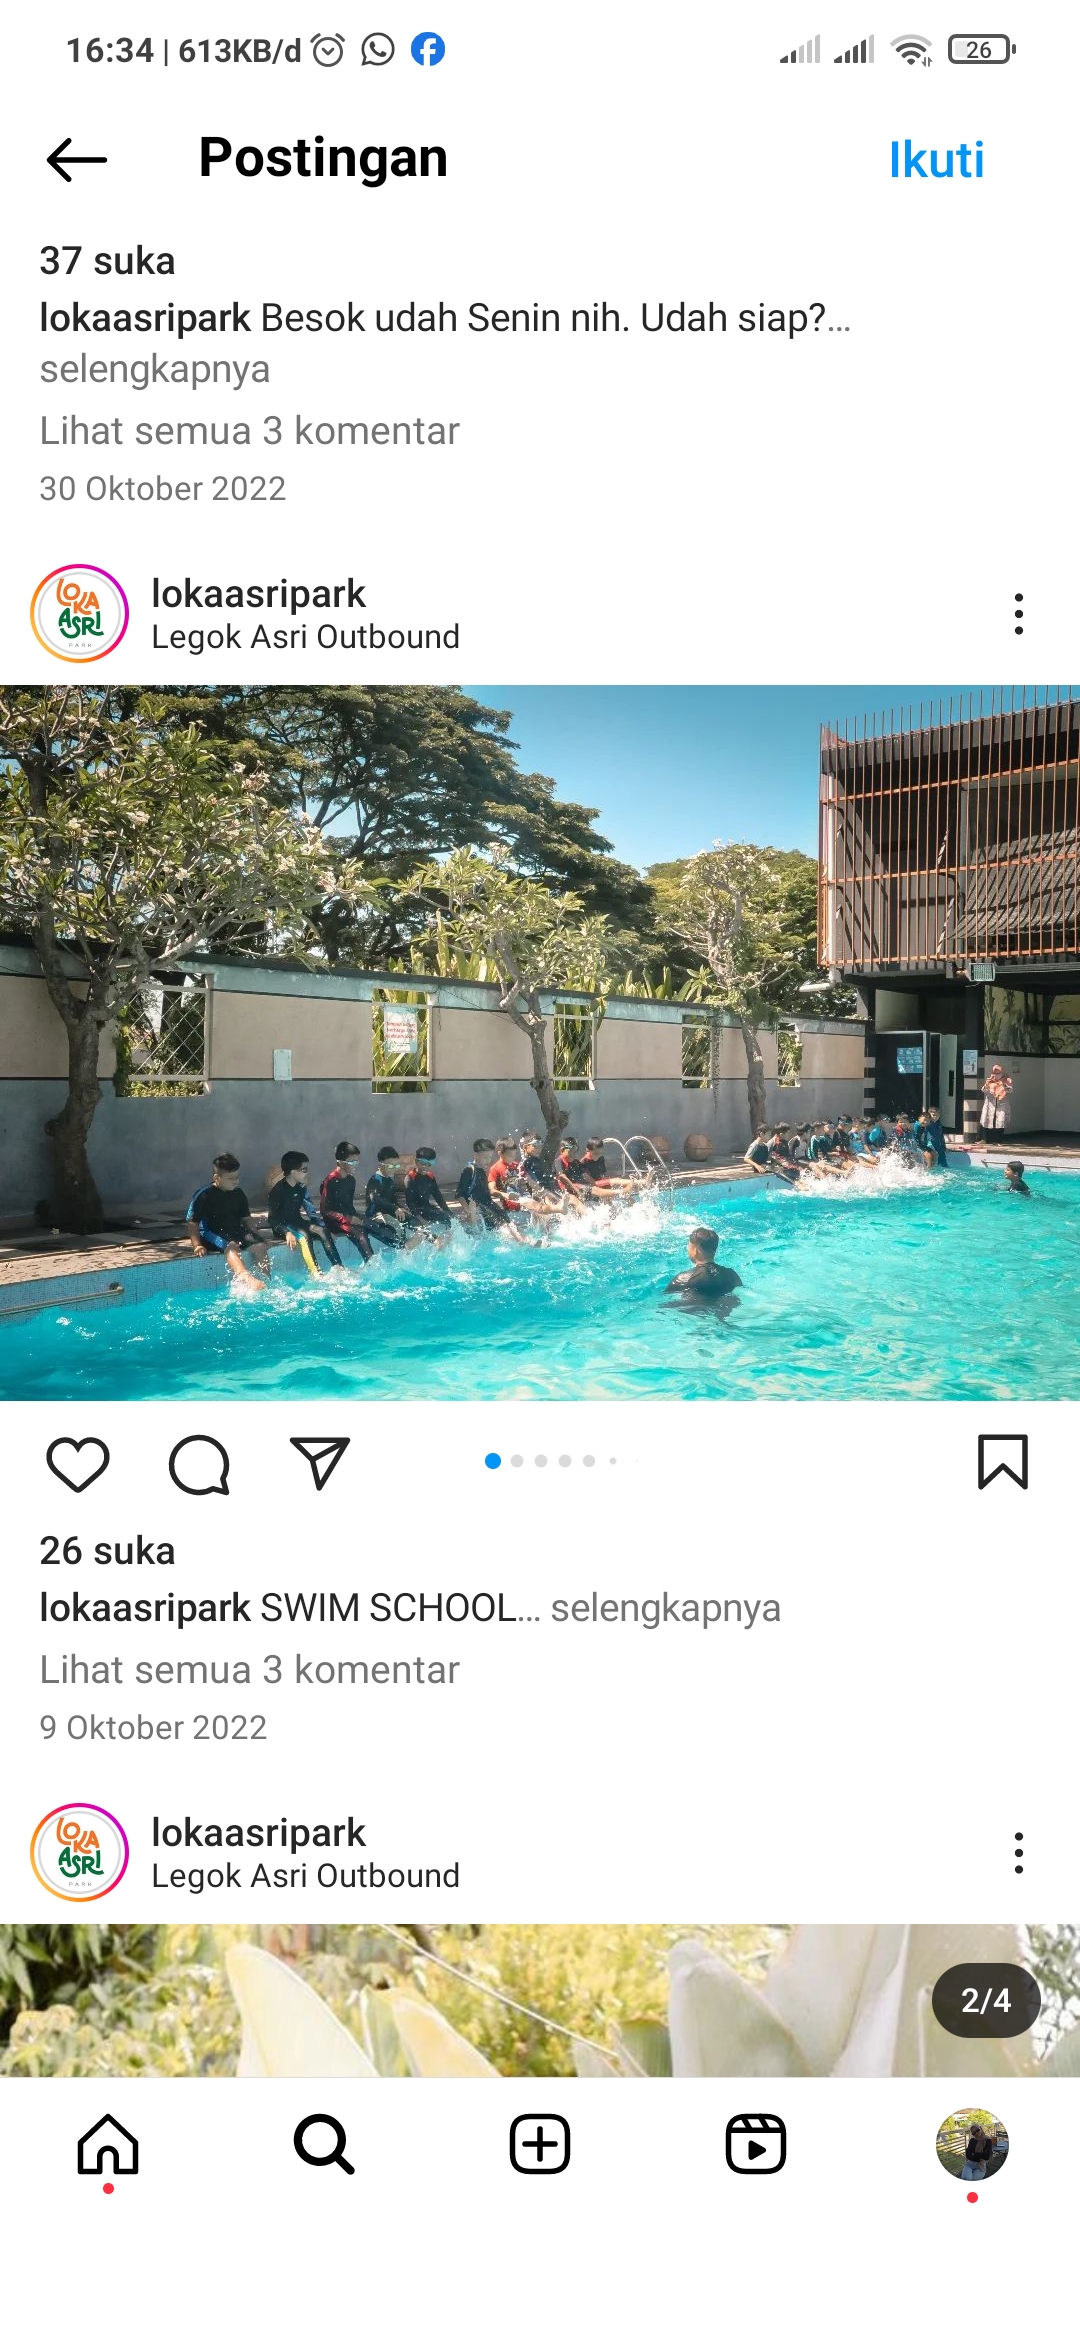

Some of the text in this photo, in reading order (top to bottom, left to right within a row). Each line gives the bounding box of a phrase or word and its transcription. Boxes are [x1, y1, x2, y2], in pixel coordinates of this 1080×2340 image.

[67, 37, 155, 63] 16:34
[179, 38, 301, 65] 613KB/d
[966, 41, 993, 59] 26
[200, 135, 447, 188] Postingan
[891, 138, 984, 179] Ikuti
[40, 245, 175, 275] 37 suka
[41, 302, 252, 340] lokaasripark
[262, 302, 366, 332] Besok
[375, 302, 457, 332] udah
[467, 302, 560, 332] Senin
[572, 302, 630, 332] nih.
[642, 302, 727, 332] Udah
[40, 353, 270, 391] selengkapnya
[41, 414, 461, 445] Lihat semua 3 komentar
[40, 475, 286, 501] 30 Oktober 2022
[56, 577, 100, 615] LOKA
[153, 577, 367, 616] lokaasripark
[58, 607, 104, 638] ASRI
[153, 622, 459, 655] Legok Asri Outbound
[40, 1535, 175, 1565] 26 suka
[41, 1591, 252, 1630] lokaasripark
[260, 1592, 360, 1622] SWIM
[551, 1591, 781, 1630] selengkapnya
[41, 1653, 461, 1684] Lihat semua 3 komentar
[40, 1714, 267, 1740] 9 Oktober 2022
[56, 1816, 100, 1854] LOKA
[153, 1816, 367, 1855] lokaasripark
[58, 1846, 104, 1877] ASRI
[153, 1861, 459, 1894] Legok Asri Outbound
[961, 1987, 1012, 2017] 2/4
